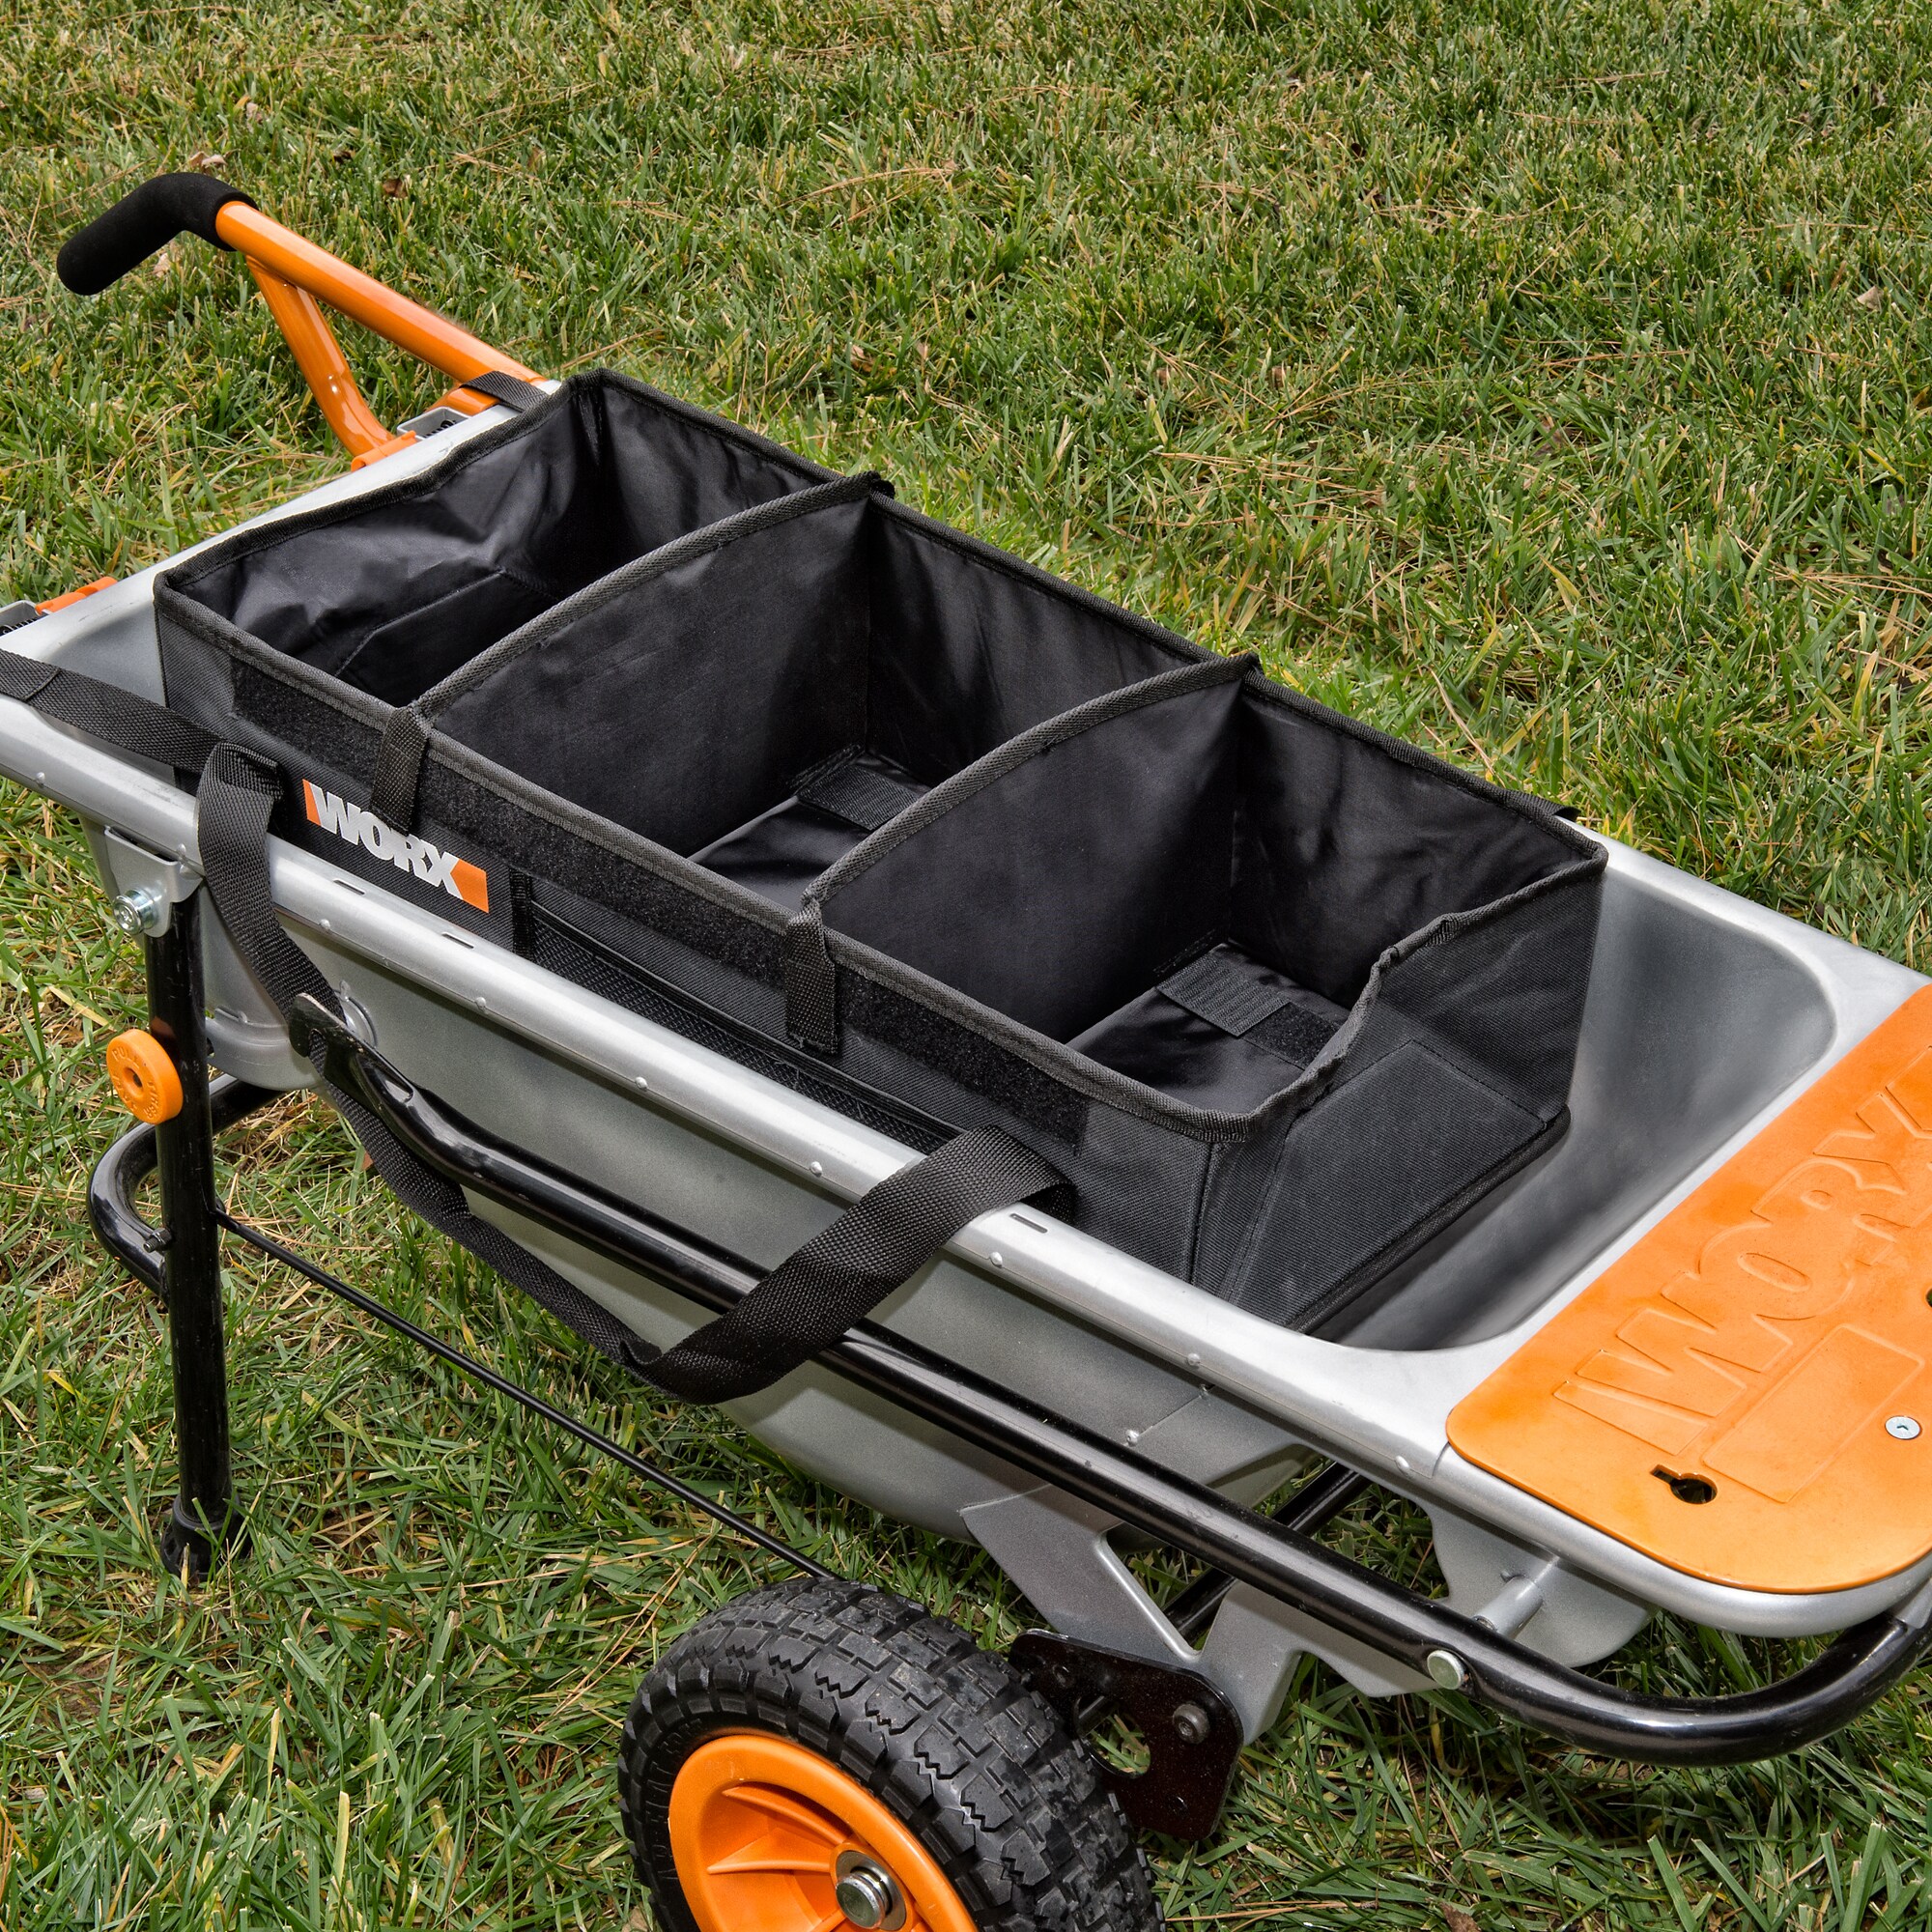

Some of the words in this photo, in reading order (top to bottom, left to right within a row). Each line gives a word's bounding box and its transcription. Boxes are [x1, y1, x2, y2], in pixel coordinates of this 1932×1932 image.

[308, 781, 464, 901] WORX
[110, 1046, 140, 1069] PULL
[1575, 1094, 1932, 1420] WORX
